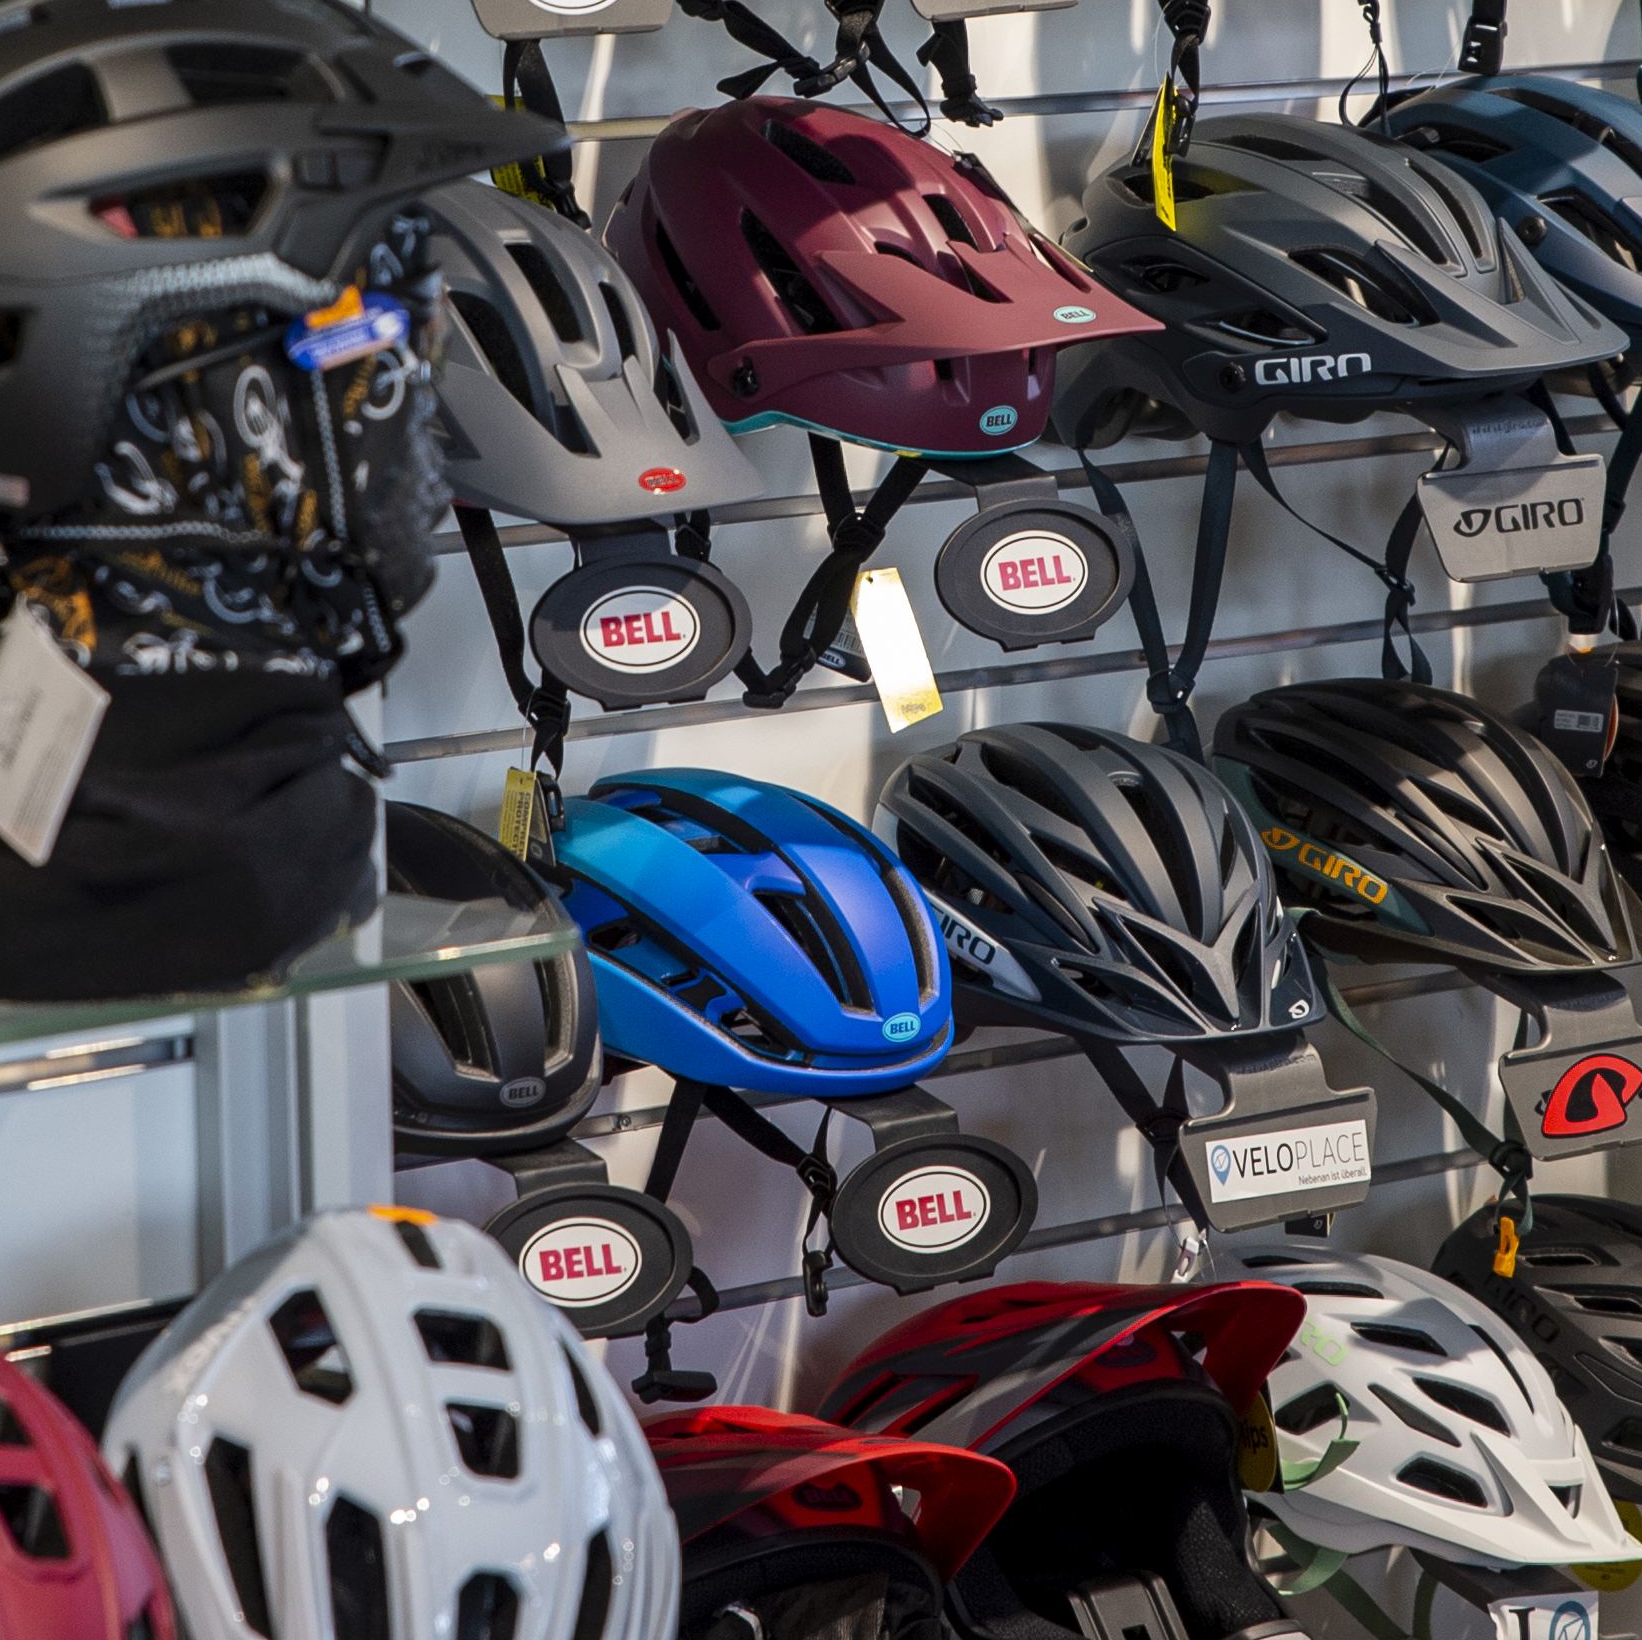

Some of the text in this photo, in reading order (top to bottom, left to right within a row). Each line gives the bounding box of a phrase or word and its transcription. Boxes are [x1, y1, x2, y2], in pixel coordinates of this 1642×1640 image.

[1062, 308, 1090, 319] BELL
[1256, 352, 1371, 386] GIRO
[984, 411, 1013, 428] BELL
[1496, 499, 1584, 533] GIRO
[998, 557, 1071, 590] BELL
[601, 613, 681, 648] BELL
[1301, 844, 1387, 904] GIRO
[889, 1021, 916, 1035] BELL
[509, 1083, 538, 1102] BELL
[1234, 1133, 1364, 1178] VELOPLACE
[1299, 1165, 1365, 1186] Nebenan ist überall.
[896, 1193, 973, 1230] BELL
[540, 1244, 622, 1281] BELL
[1301, 1320, 1348, 1365] RO
[1244, 1425, 1268, 1454] ips
